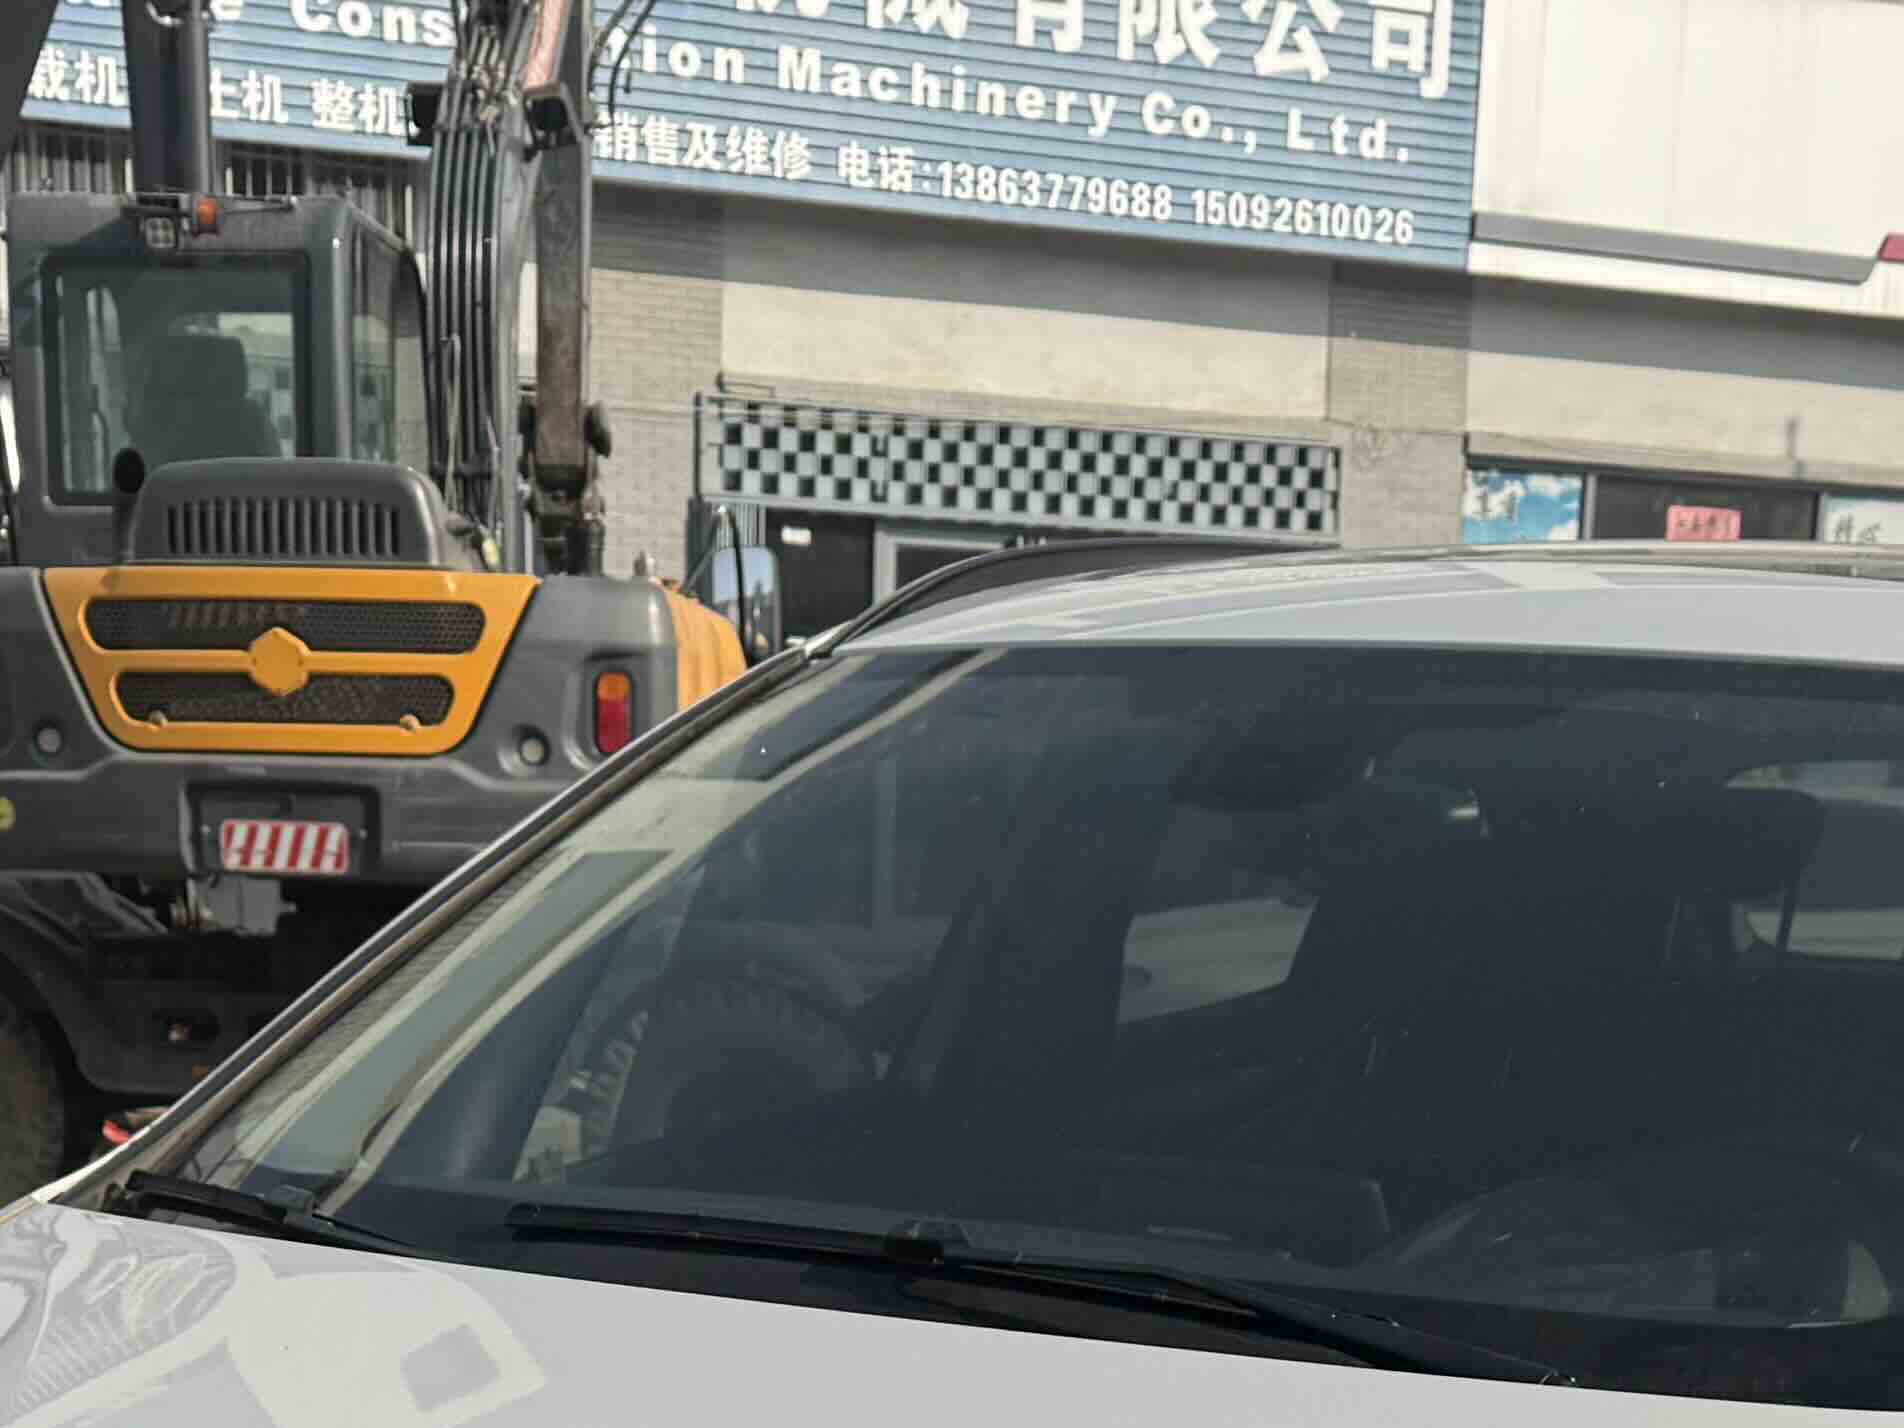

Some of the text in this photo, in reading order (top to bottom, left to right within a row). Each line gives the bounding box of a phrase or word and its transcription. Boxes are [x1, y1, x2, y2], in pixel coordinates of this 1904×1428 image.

[777, 45, 1116, 137] Machinery
[1141, 91, 1258, 154] Co.,
[1286, 108, 1409, 162] Ltd.
[1192, 190, 1415, 244] 15092610026
